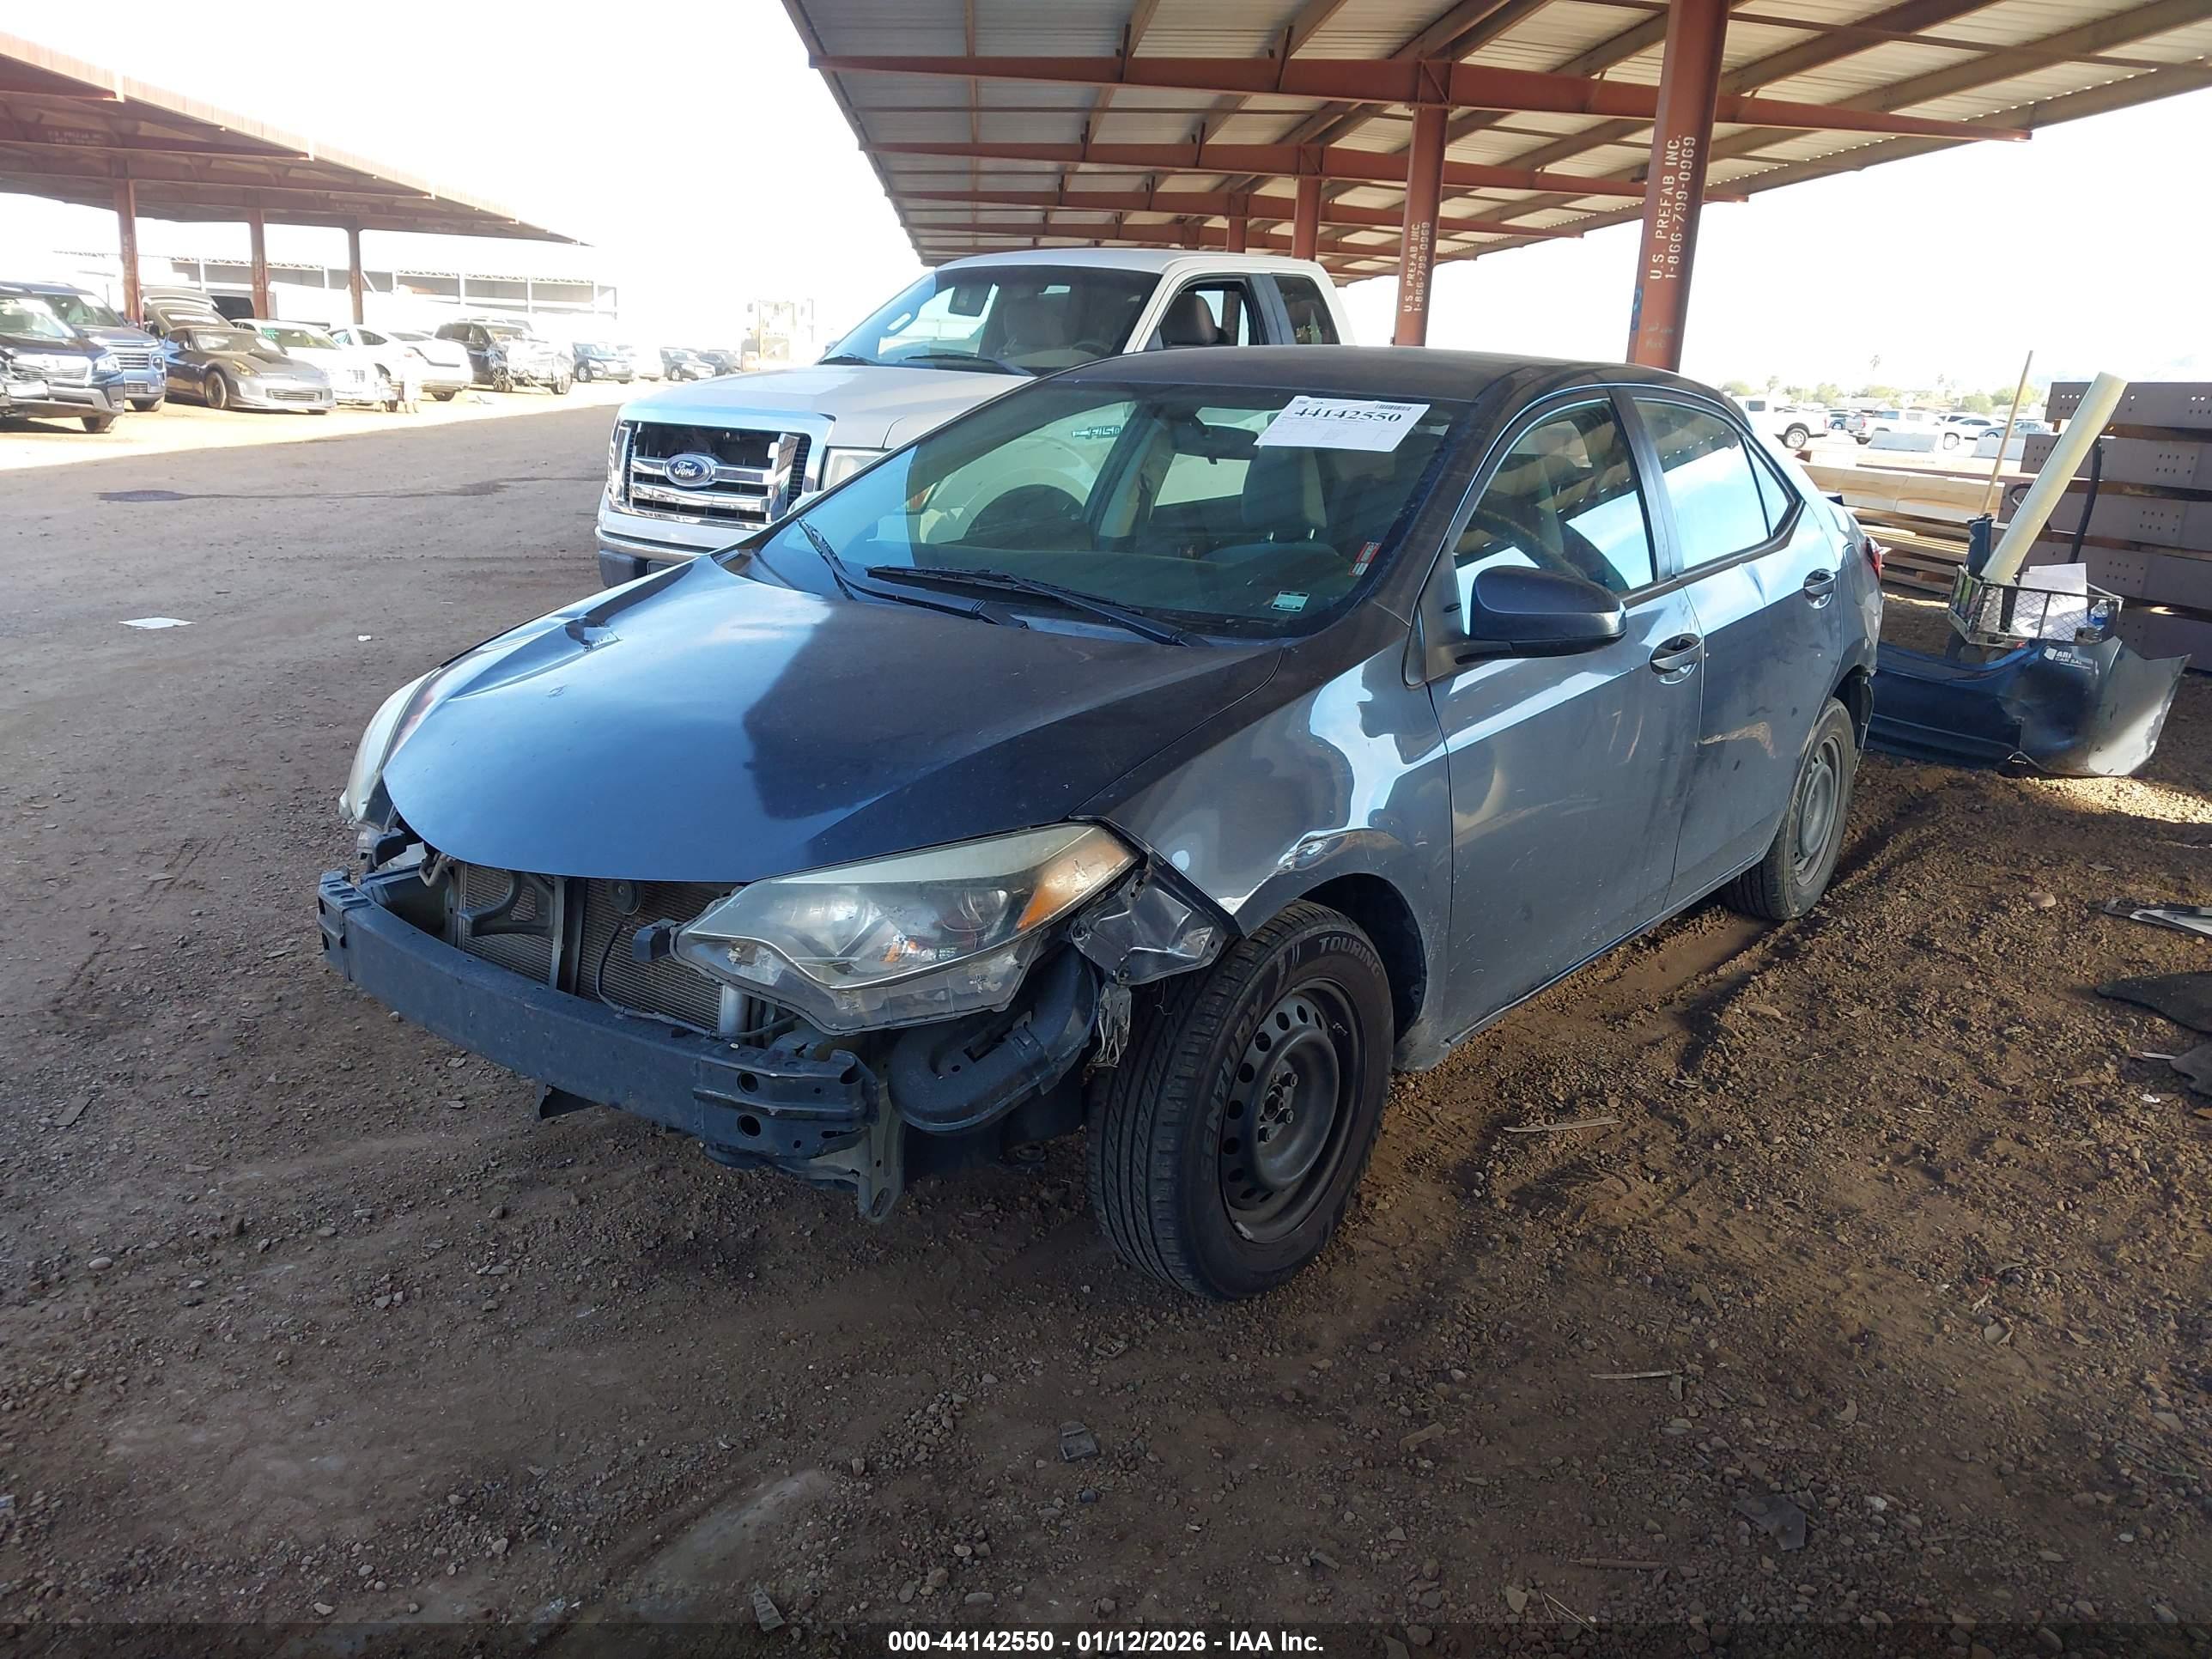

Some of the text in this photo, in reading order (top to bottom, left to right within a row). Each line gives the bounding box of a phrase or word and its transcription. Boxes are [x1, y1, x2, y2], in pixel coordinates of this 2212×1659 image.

[1664, 134, 1681, 166] INC.
[1655, 174, 1675, 240] PREFAB
[1664, 136, 1697, 279] 1-866-799-0969
[1406, 246, 1419, 287] PREFAB
[1293, 407, 1402, 422] 44142550
[674, 460, 698, 477] Ford
[1318, 935, 1382, 977] TOURING
